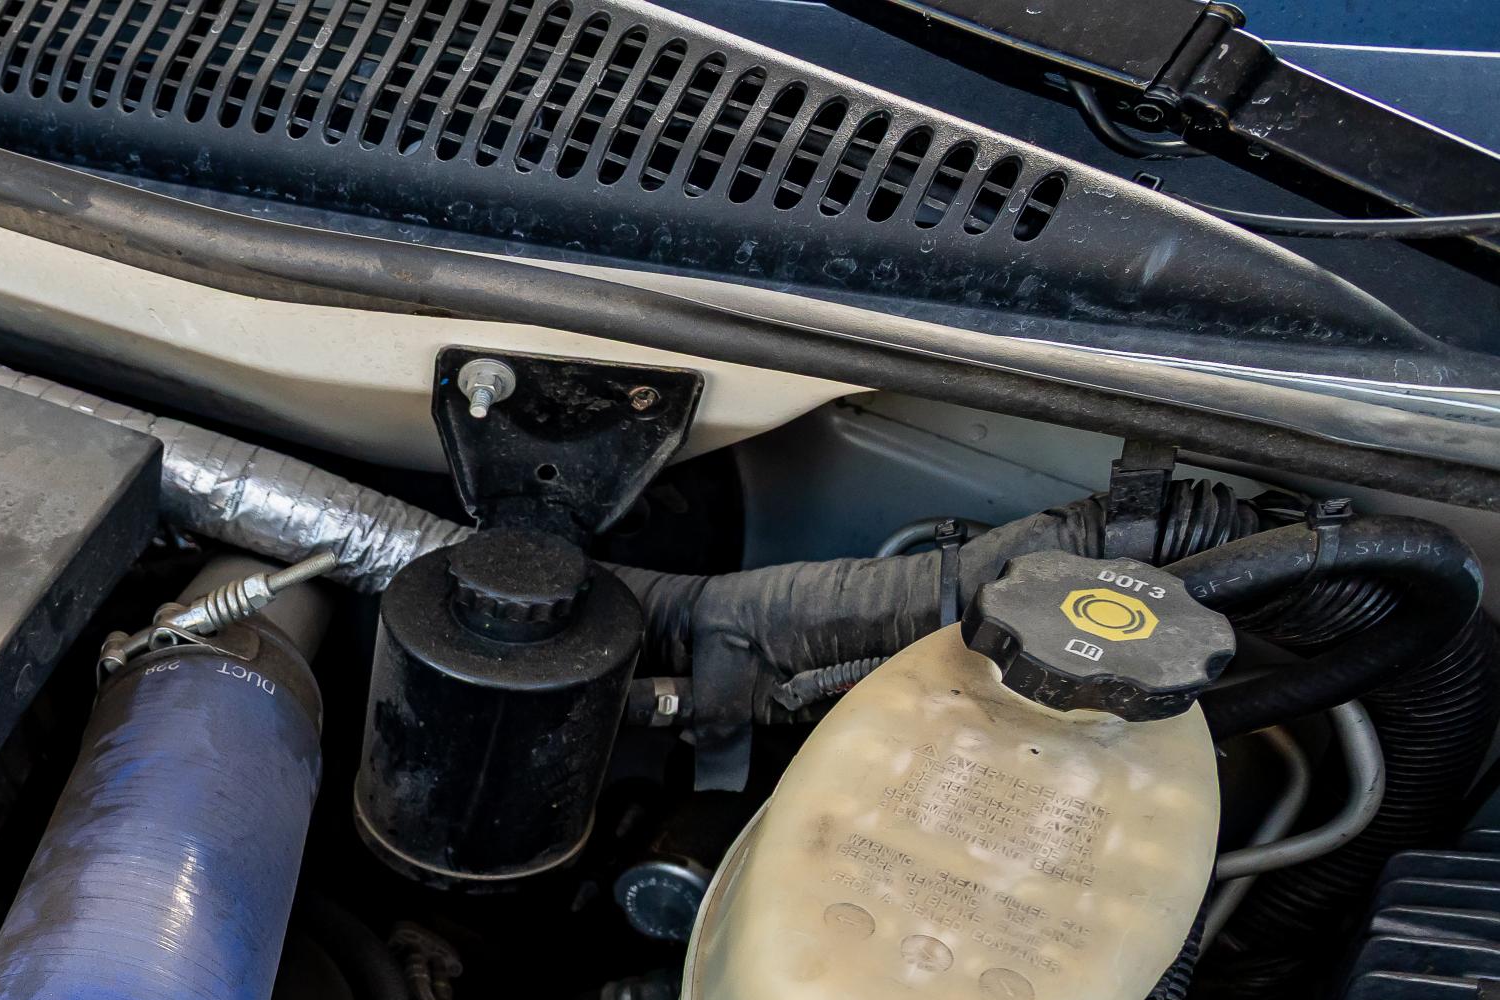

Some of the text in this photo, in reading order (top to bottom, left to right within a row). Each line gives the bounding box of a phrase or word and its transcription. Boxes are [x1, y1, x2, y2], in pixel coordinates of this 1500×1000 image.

[1096, 570, 1167, 600] DOT 3
[216, 661, 276, 696] DUCT
